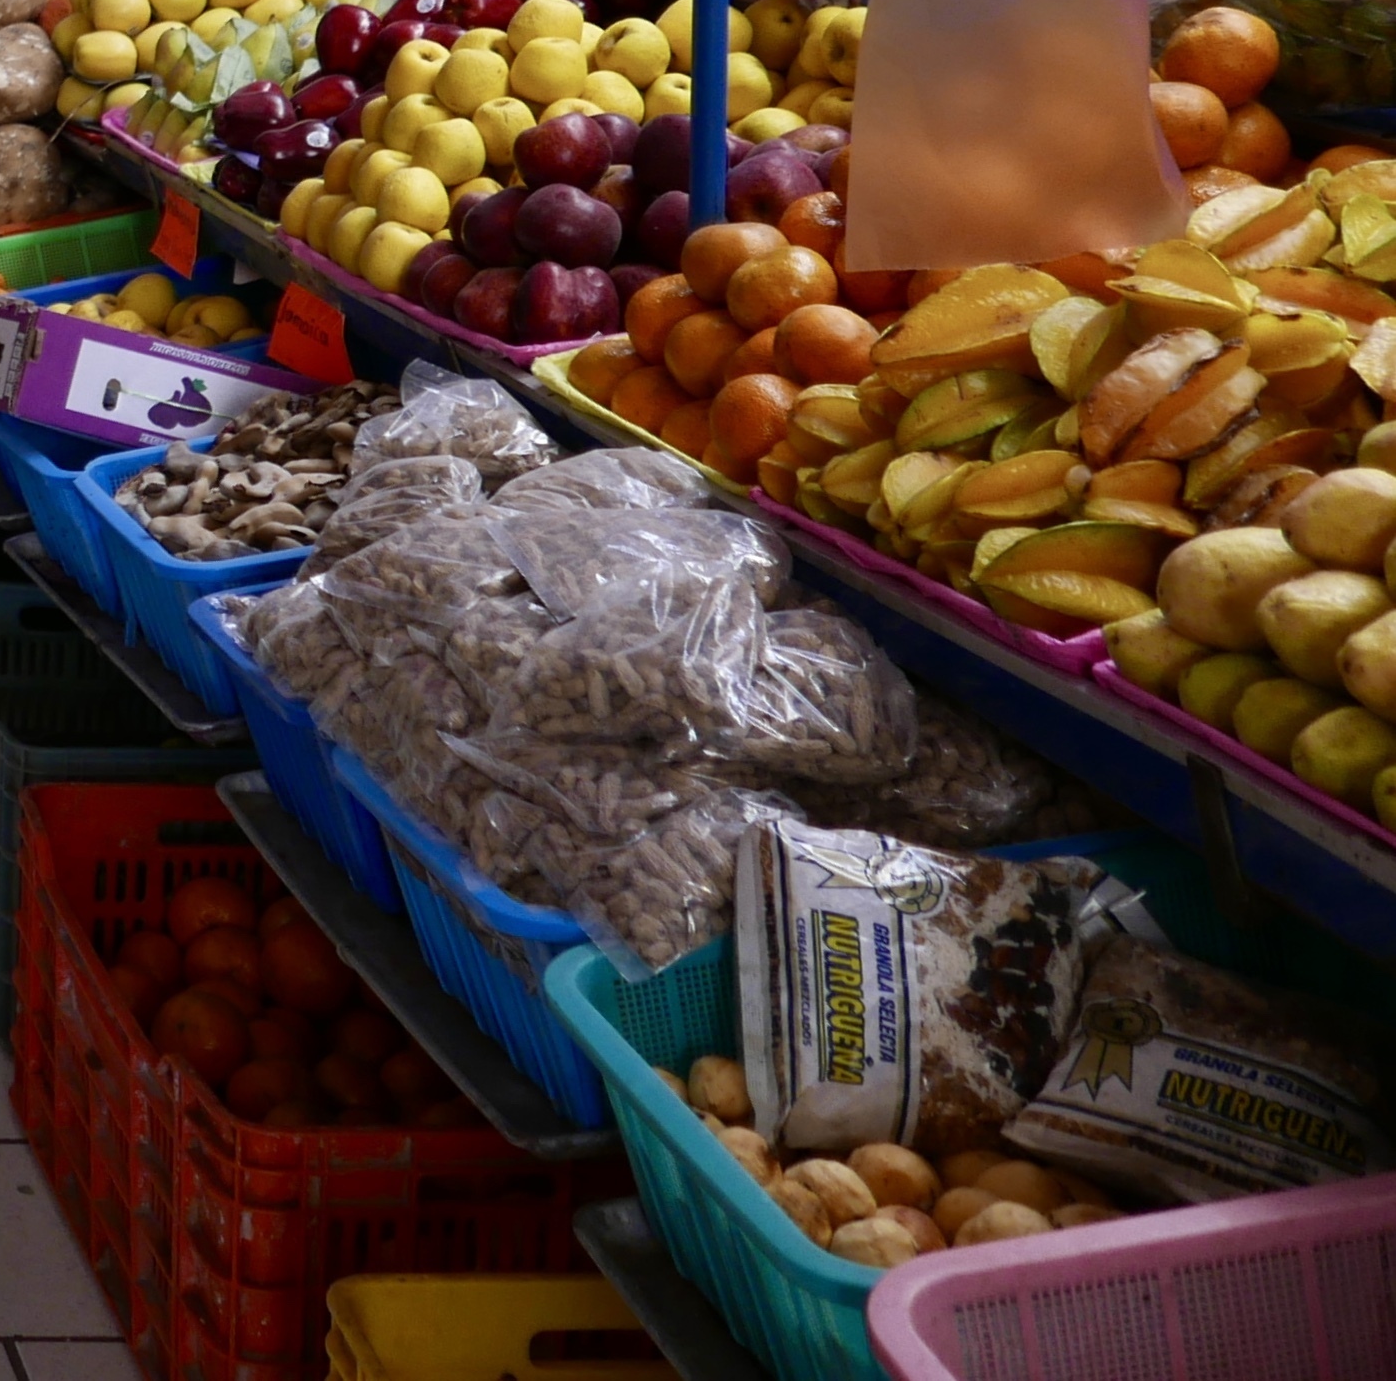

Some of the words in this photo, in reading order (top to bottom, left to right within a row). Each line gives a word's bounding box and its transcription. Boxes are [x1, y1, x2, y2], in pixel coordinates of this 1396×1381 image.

[872, 923, 895, 994] GRANOLA
[878, 997, 897, 1064] SELECTA
[1174, 1048, 1258, 1083] GRANOLA
